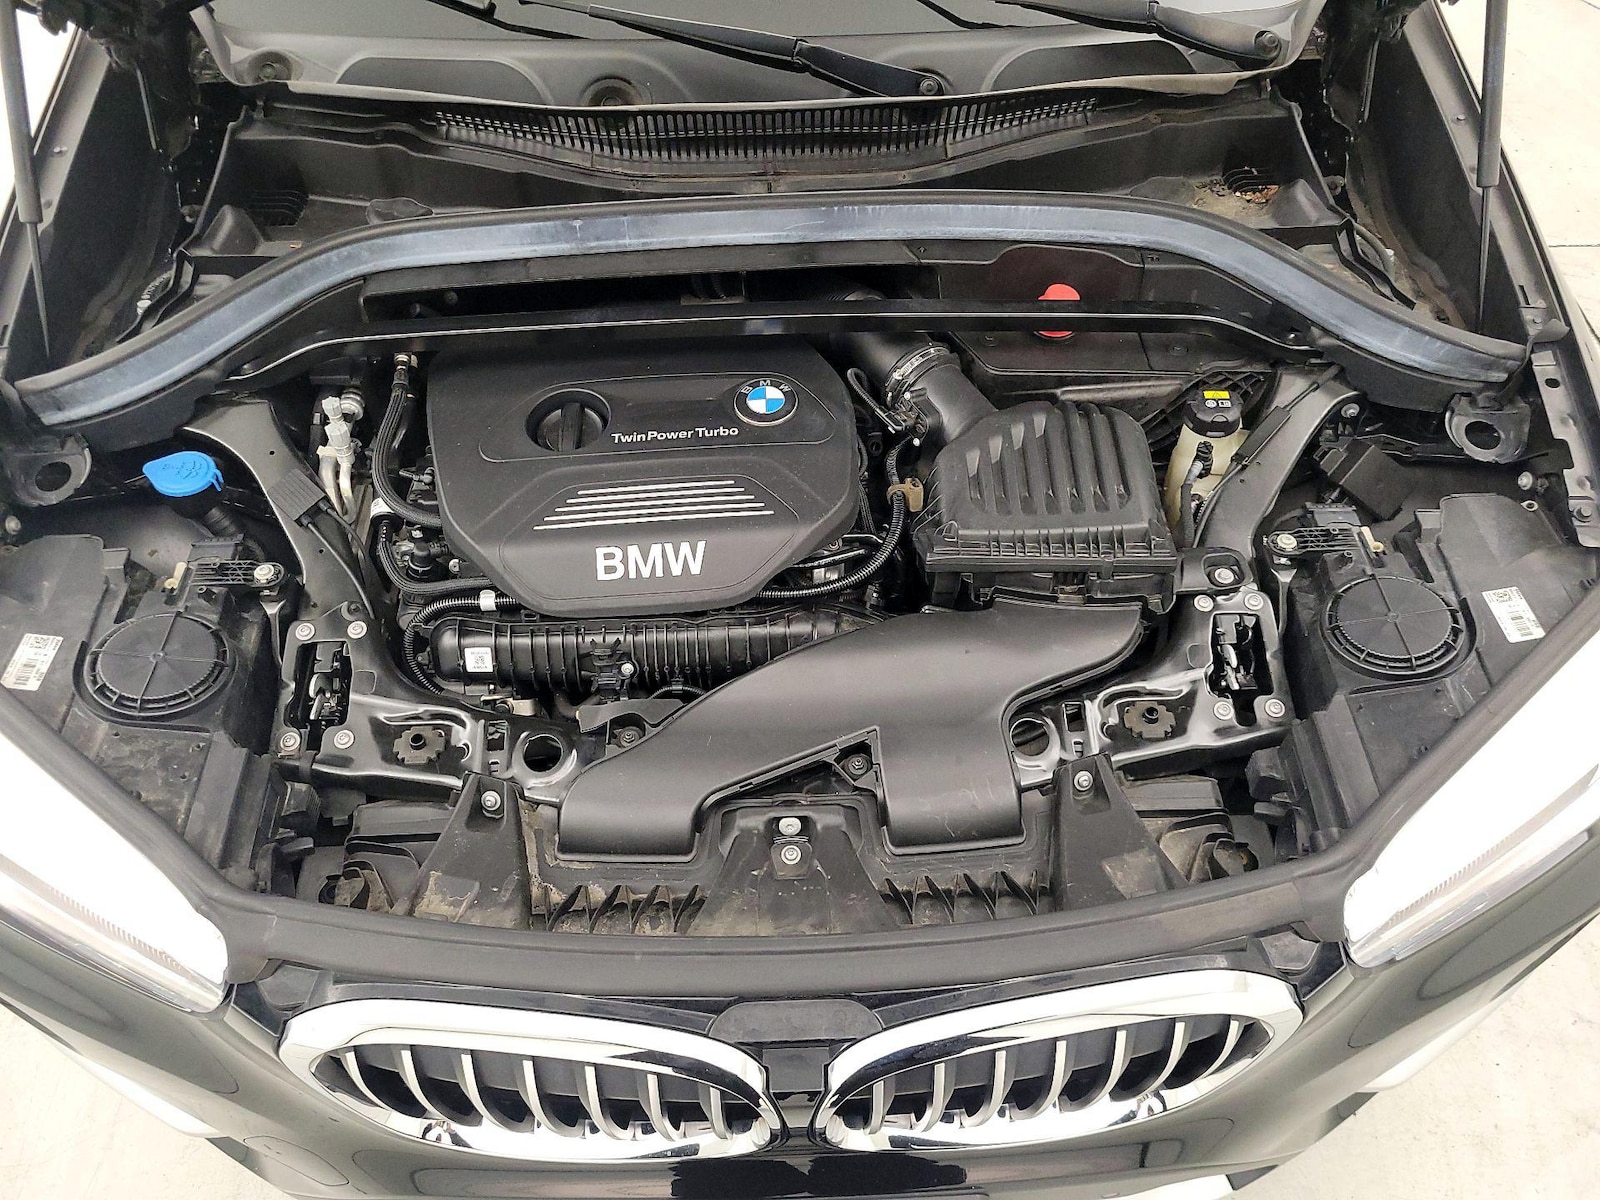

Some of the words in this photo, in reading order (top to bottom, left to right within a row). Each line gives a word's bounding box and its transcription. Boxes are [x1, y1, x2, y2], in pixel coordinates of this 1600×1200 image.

[740, 380, 791, 394] BMW
[695, 426, 739, 438] Turbo
[595, 540, 706, 581] BMW
